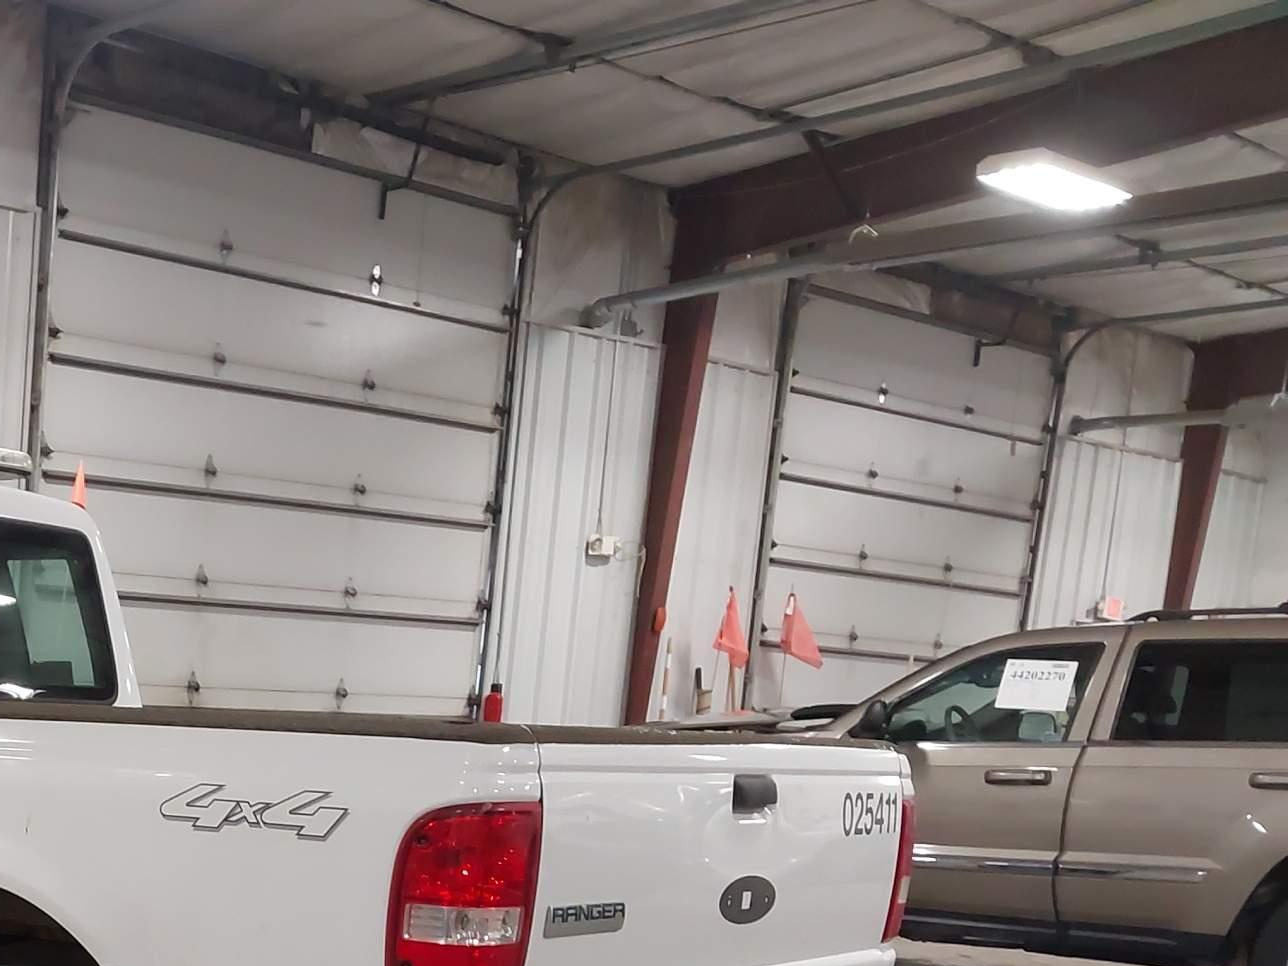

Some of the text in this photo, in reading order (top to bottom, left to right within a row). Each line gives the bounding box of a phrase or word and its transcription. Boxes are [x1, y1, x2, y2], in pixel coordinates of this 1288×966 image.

[1009, 670, 1066, 681] 44202270
[160, 783, 350, 841] 4x4
[842, 792, 897, 836] 025411
[551, 903, 626, 924] RANGER
